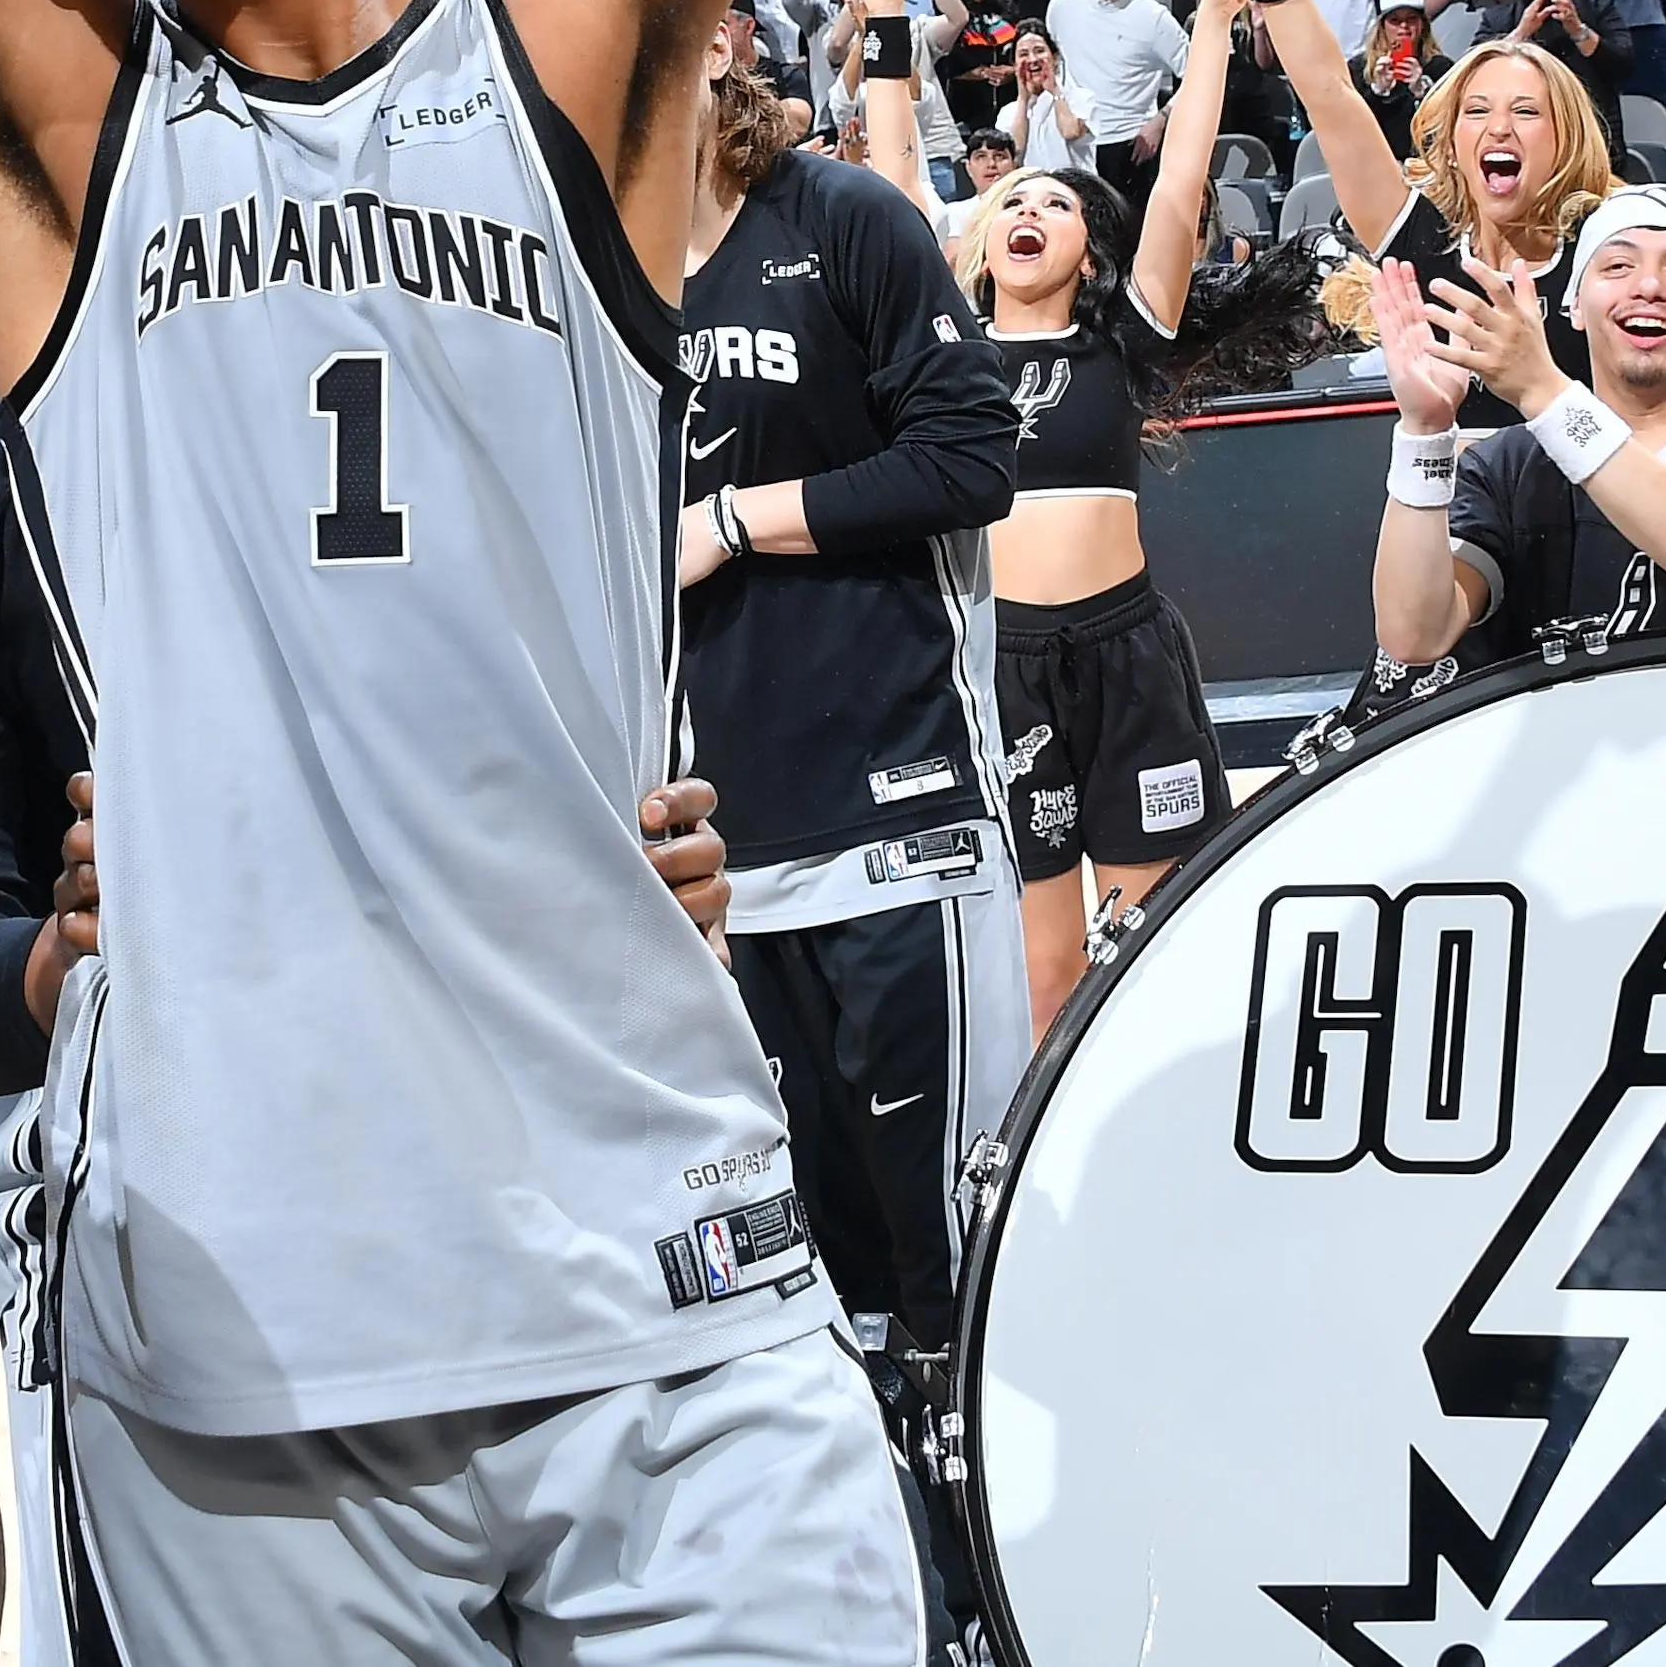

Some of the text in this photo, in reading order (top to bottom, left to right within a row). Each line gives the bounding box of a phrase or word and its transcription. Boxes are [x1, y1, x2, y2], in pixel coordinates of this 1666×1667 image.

[399, 91, 494, 130] LEDGER
[769, 261, 812, 278] LEDGER
[309, 351, 412, 567] 1
[1144, 776, 1197, 792] THE OFFICIAL
[1030, 784, 1076, 813] HYPE
[1146, 795, 1200, 818] SPURS
[1029, 806, 1079, 831] SQUAD
[1234, 883, 1528, 1173] GO
[683, 1162, 721, 1191] GO
[734, 1232, 750, 1248] 52
